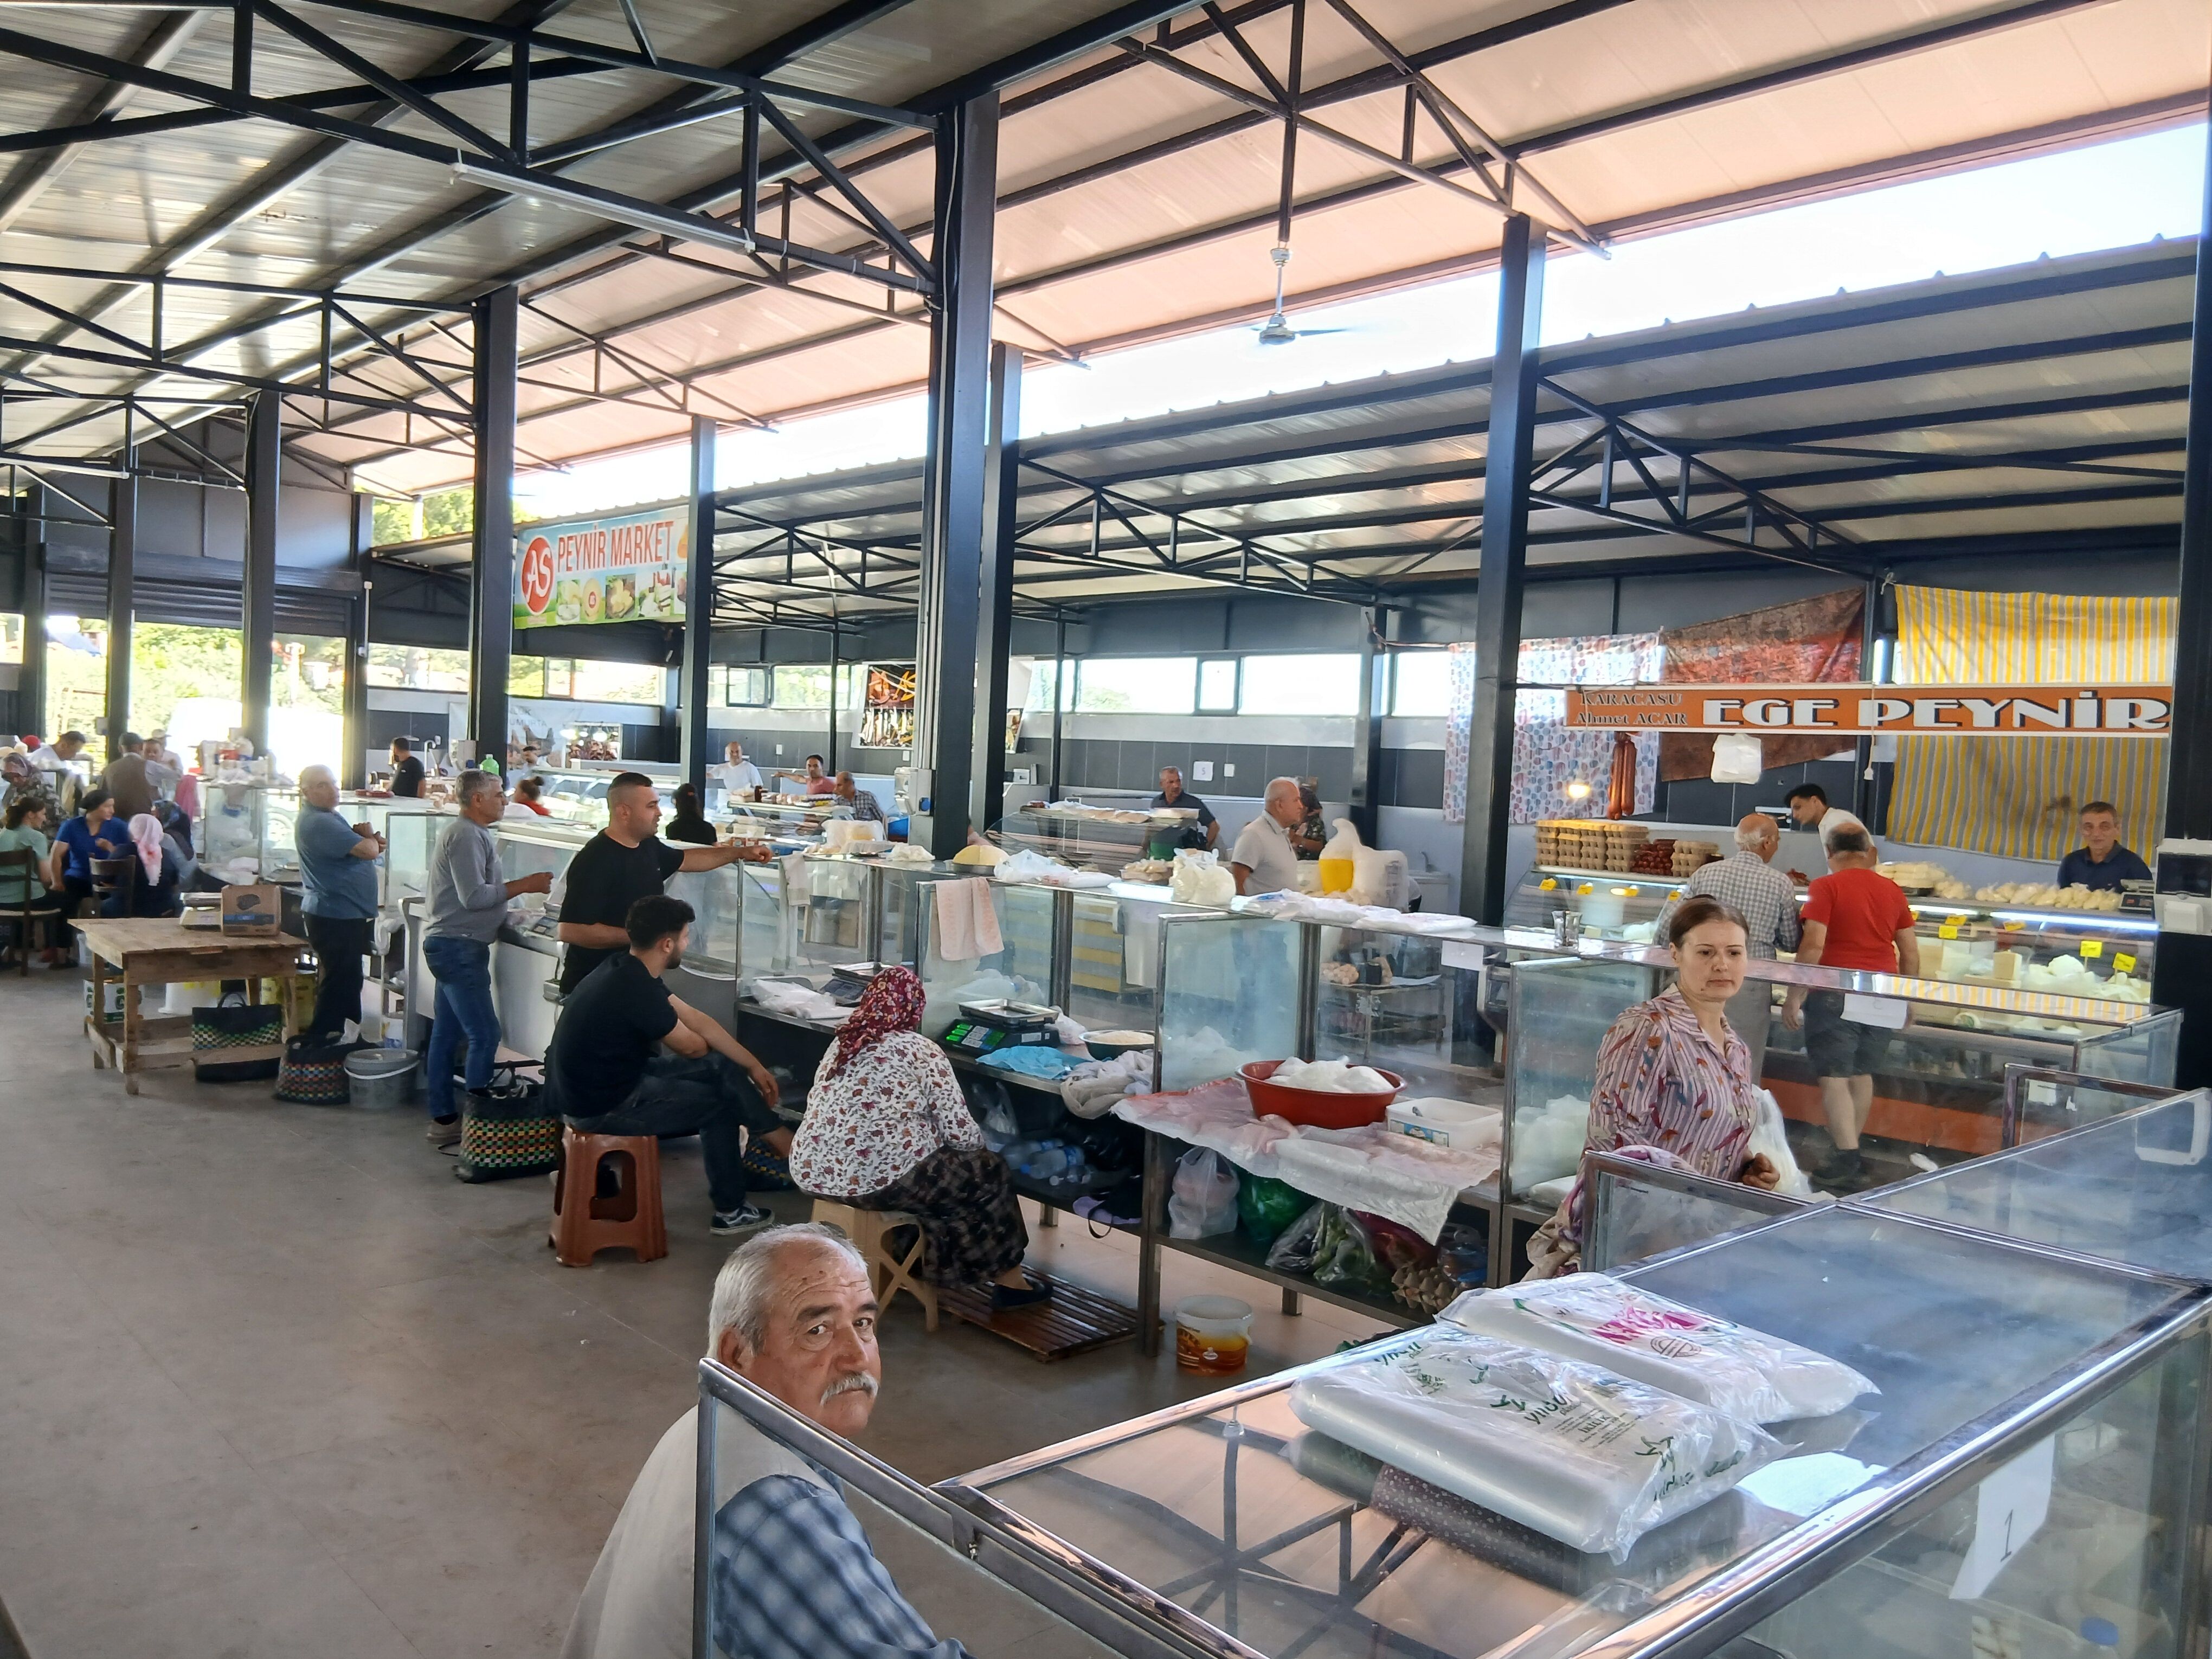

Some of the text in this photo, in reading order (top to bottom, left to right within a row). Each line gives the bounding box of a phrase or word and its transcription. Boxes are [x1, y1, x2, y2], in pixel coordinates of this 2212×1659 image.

[558, 520, 674, 572] PEYNİR MARKET
[526, 547, 551, 603] AS
[1574, 711, 1688, 725] Ahmet ACAR
[1579, 692, 1682, 706] KARACASU
[1702, 690, 2171, 729] EGE PEYNİR
[509, 718, 548, 726] UMURTA
[2001, 1509, 2014, 1562] 1
